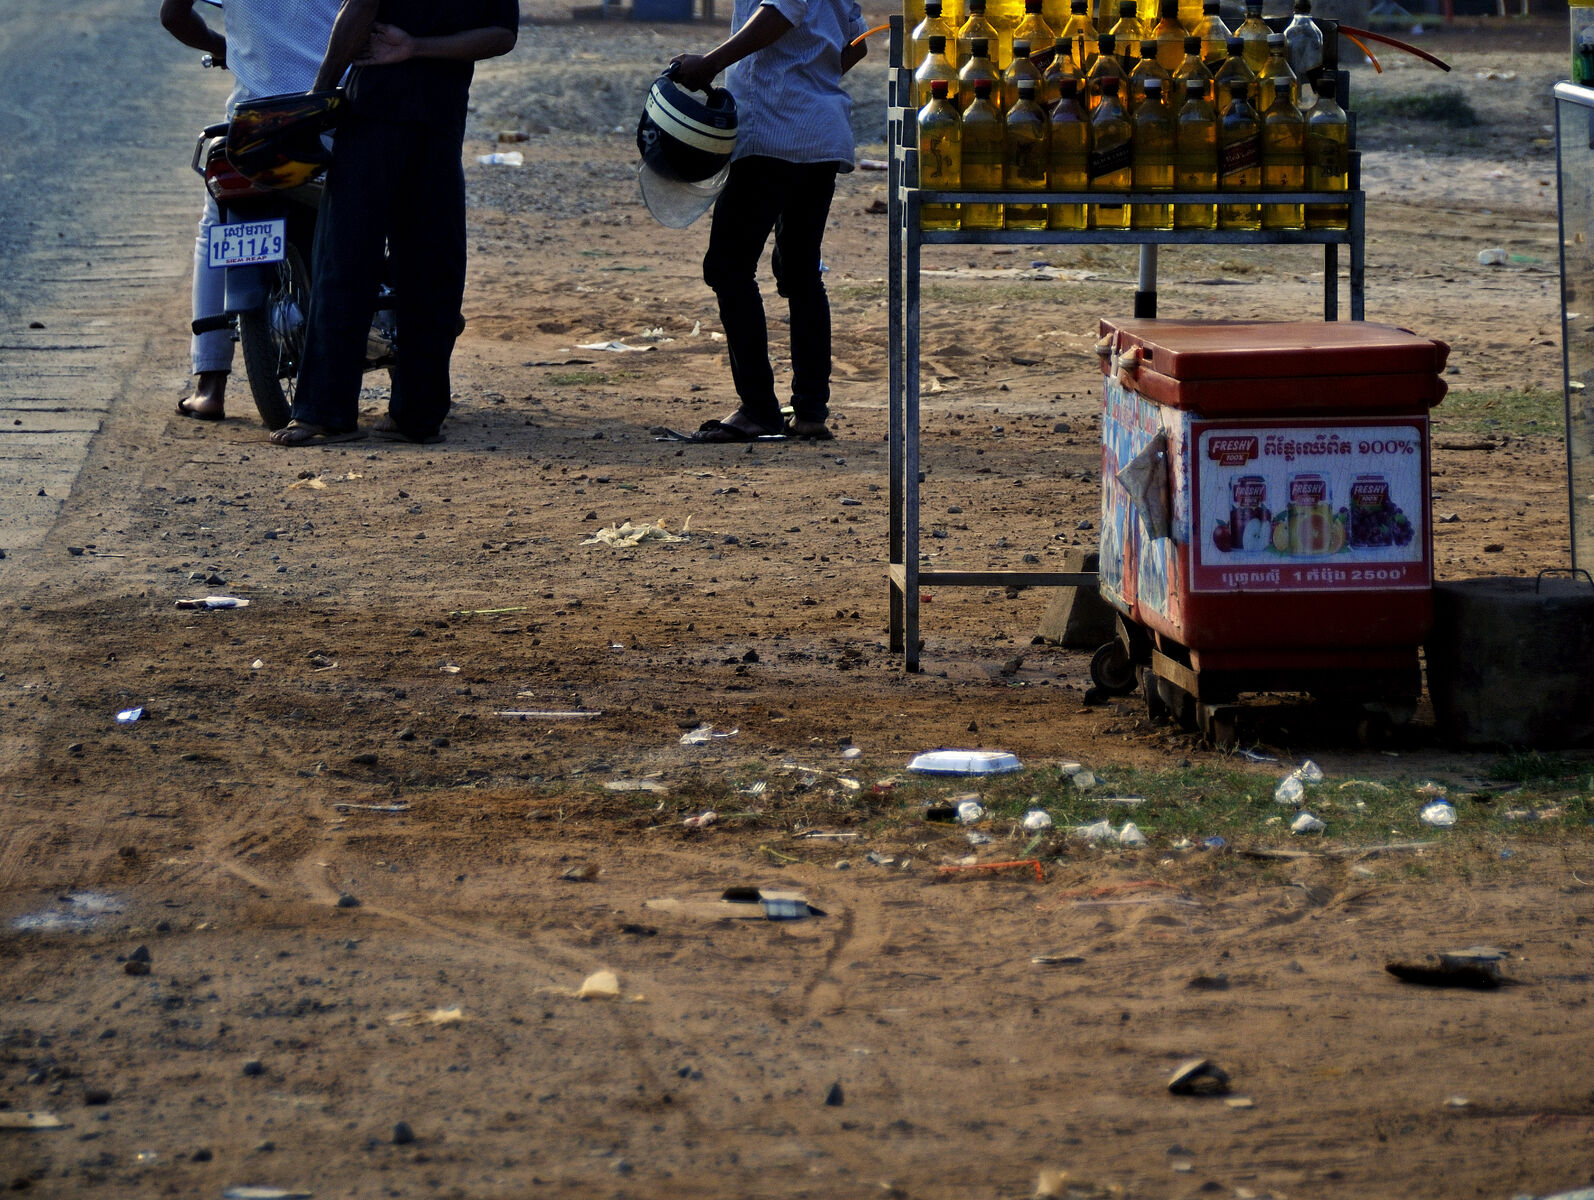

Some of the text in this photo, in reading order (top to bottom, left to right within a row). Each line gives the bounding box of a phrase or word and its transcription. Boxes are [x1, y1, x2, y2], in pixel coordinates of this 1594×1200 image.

[1212, 438, 1255, 453] FRESHY
[1292, 483, 1324, 495] FRESHY
[1353, 484, 1386, 494] FRESHY
[1293, 570, 1302, 581] 1
